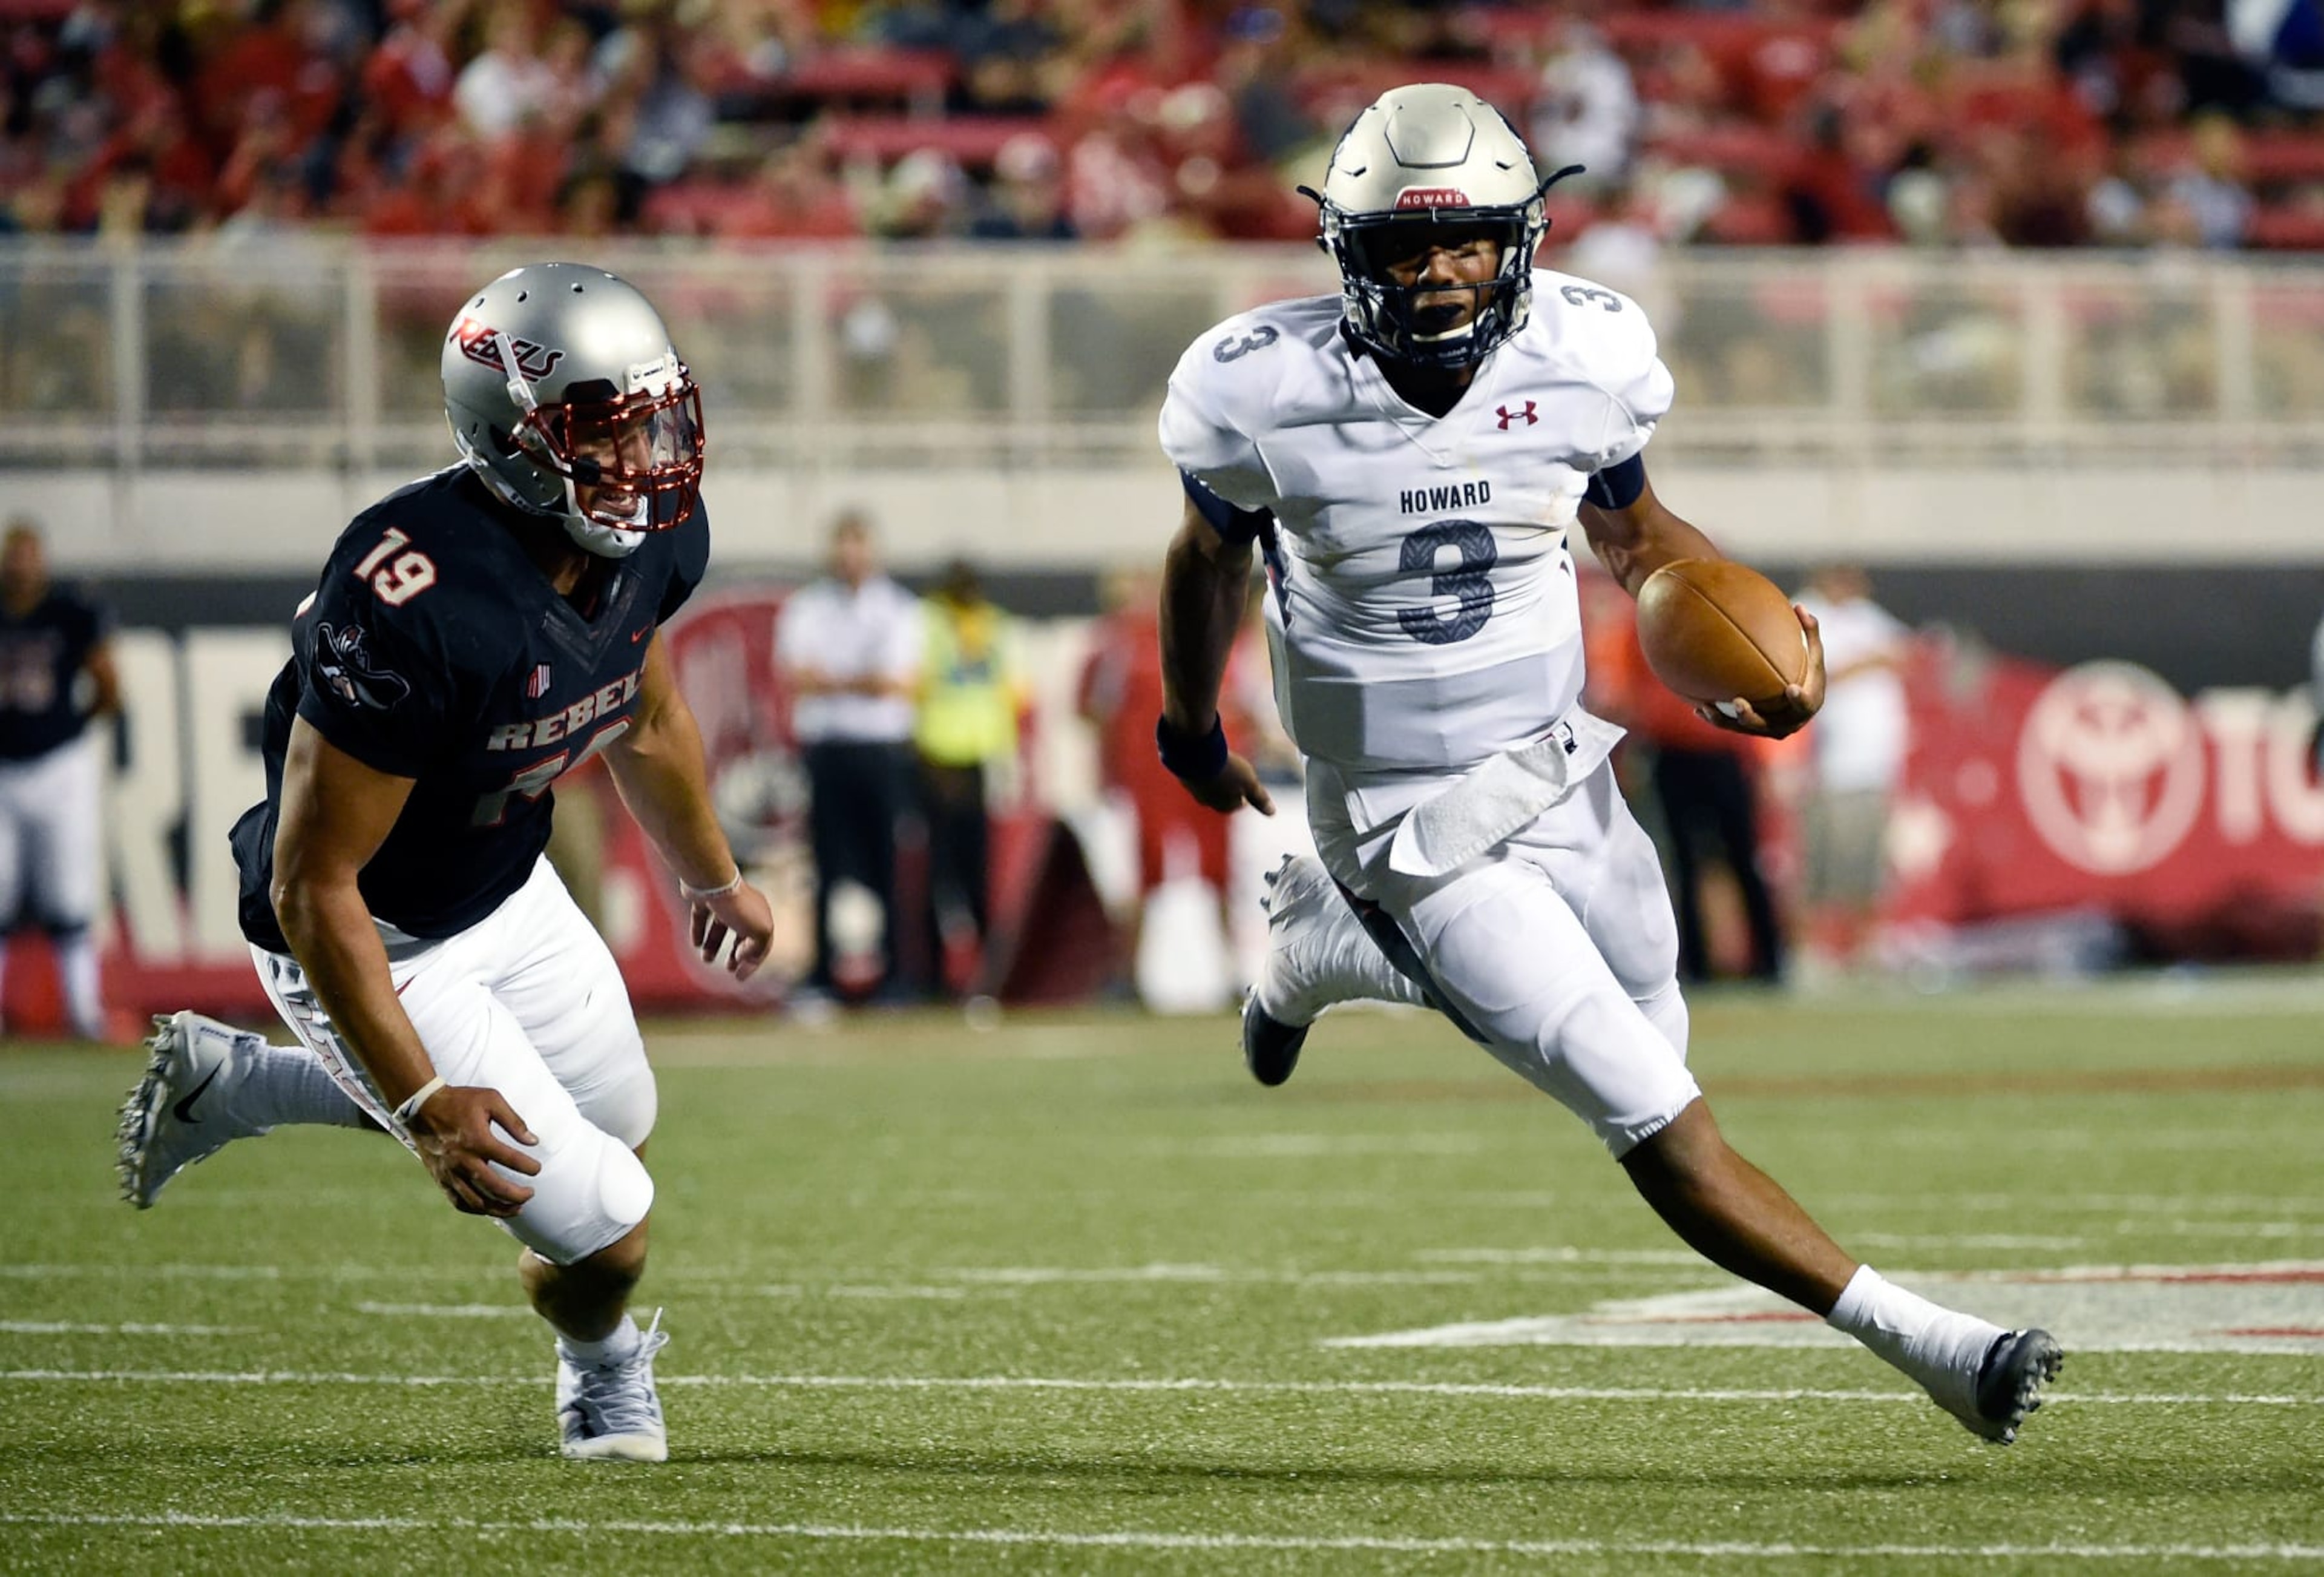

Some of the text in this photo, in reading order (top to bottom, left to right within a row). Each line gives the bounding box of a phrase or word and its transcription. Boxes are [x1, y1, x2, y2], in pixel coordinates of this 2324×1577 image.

[1402, 194, 1463, 205] HOWARD
[1560, 286, 1622, 312] 3
[1213, 325, 1279, 363] 3
[1400, 481, 1491, 513] HOWARD
[352, 525, 438, 607] 19
[1397, 519, 1498, 645] 3
[486, 665, 646, 751] REBEL
